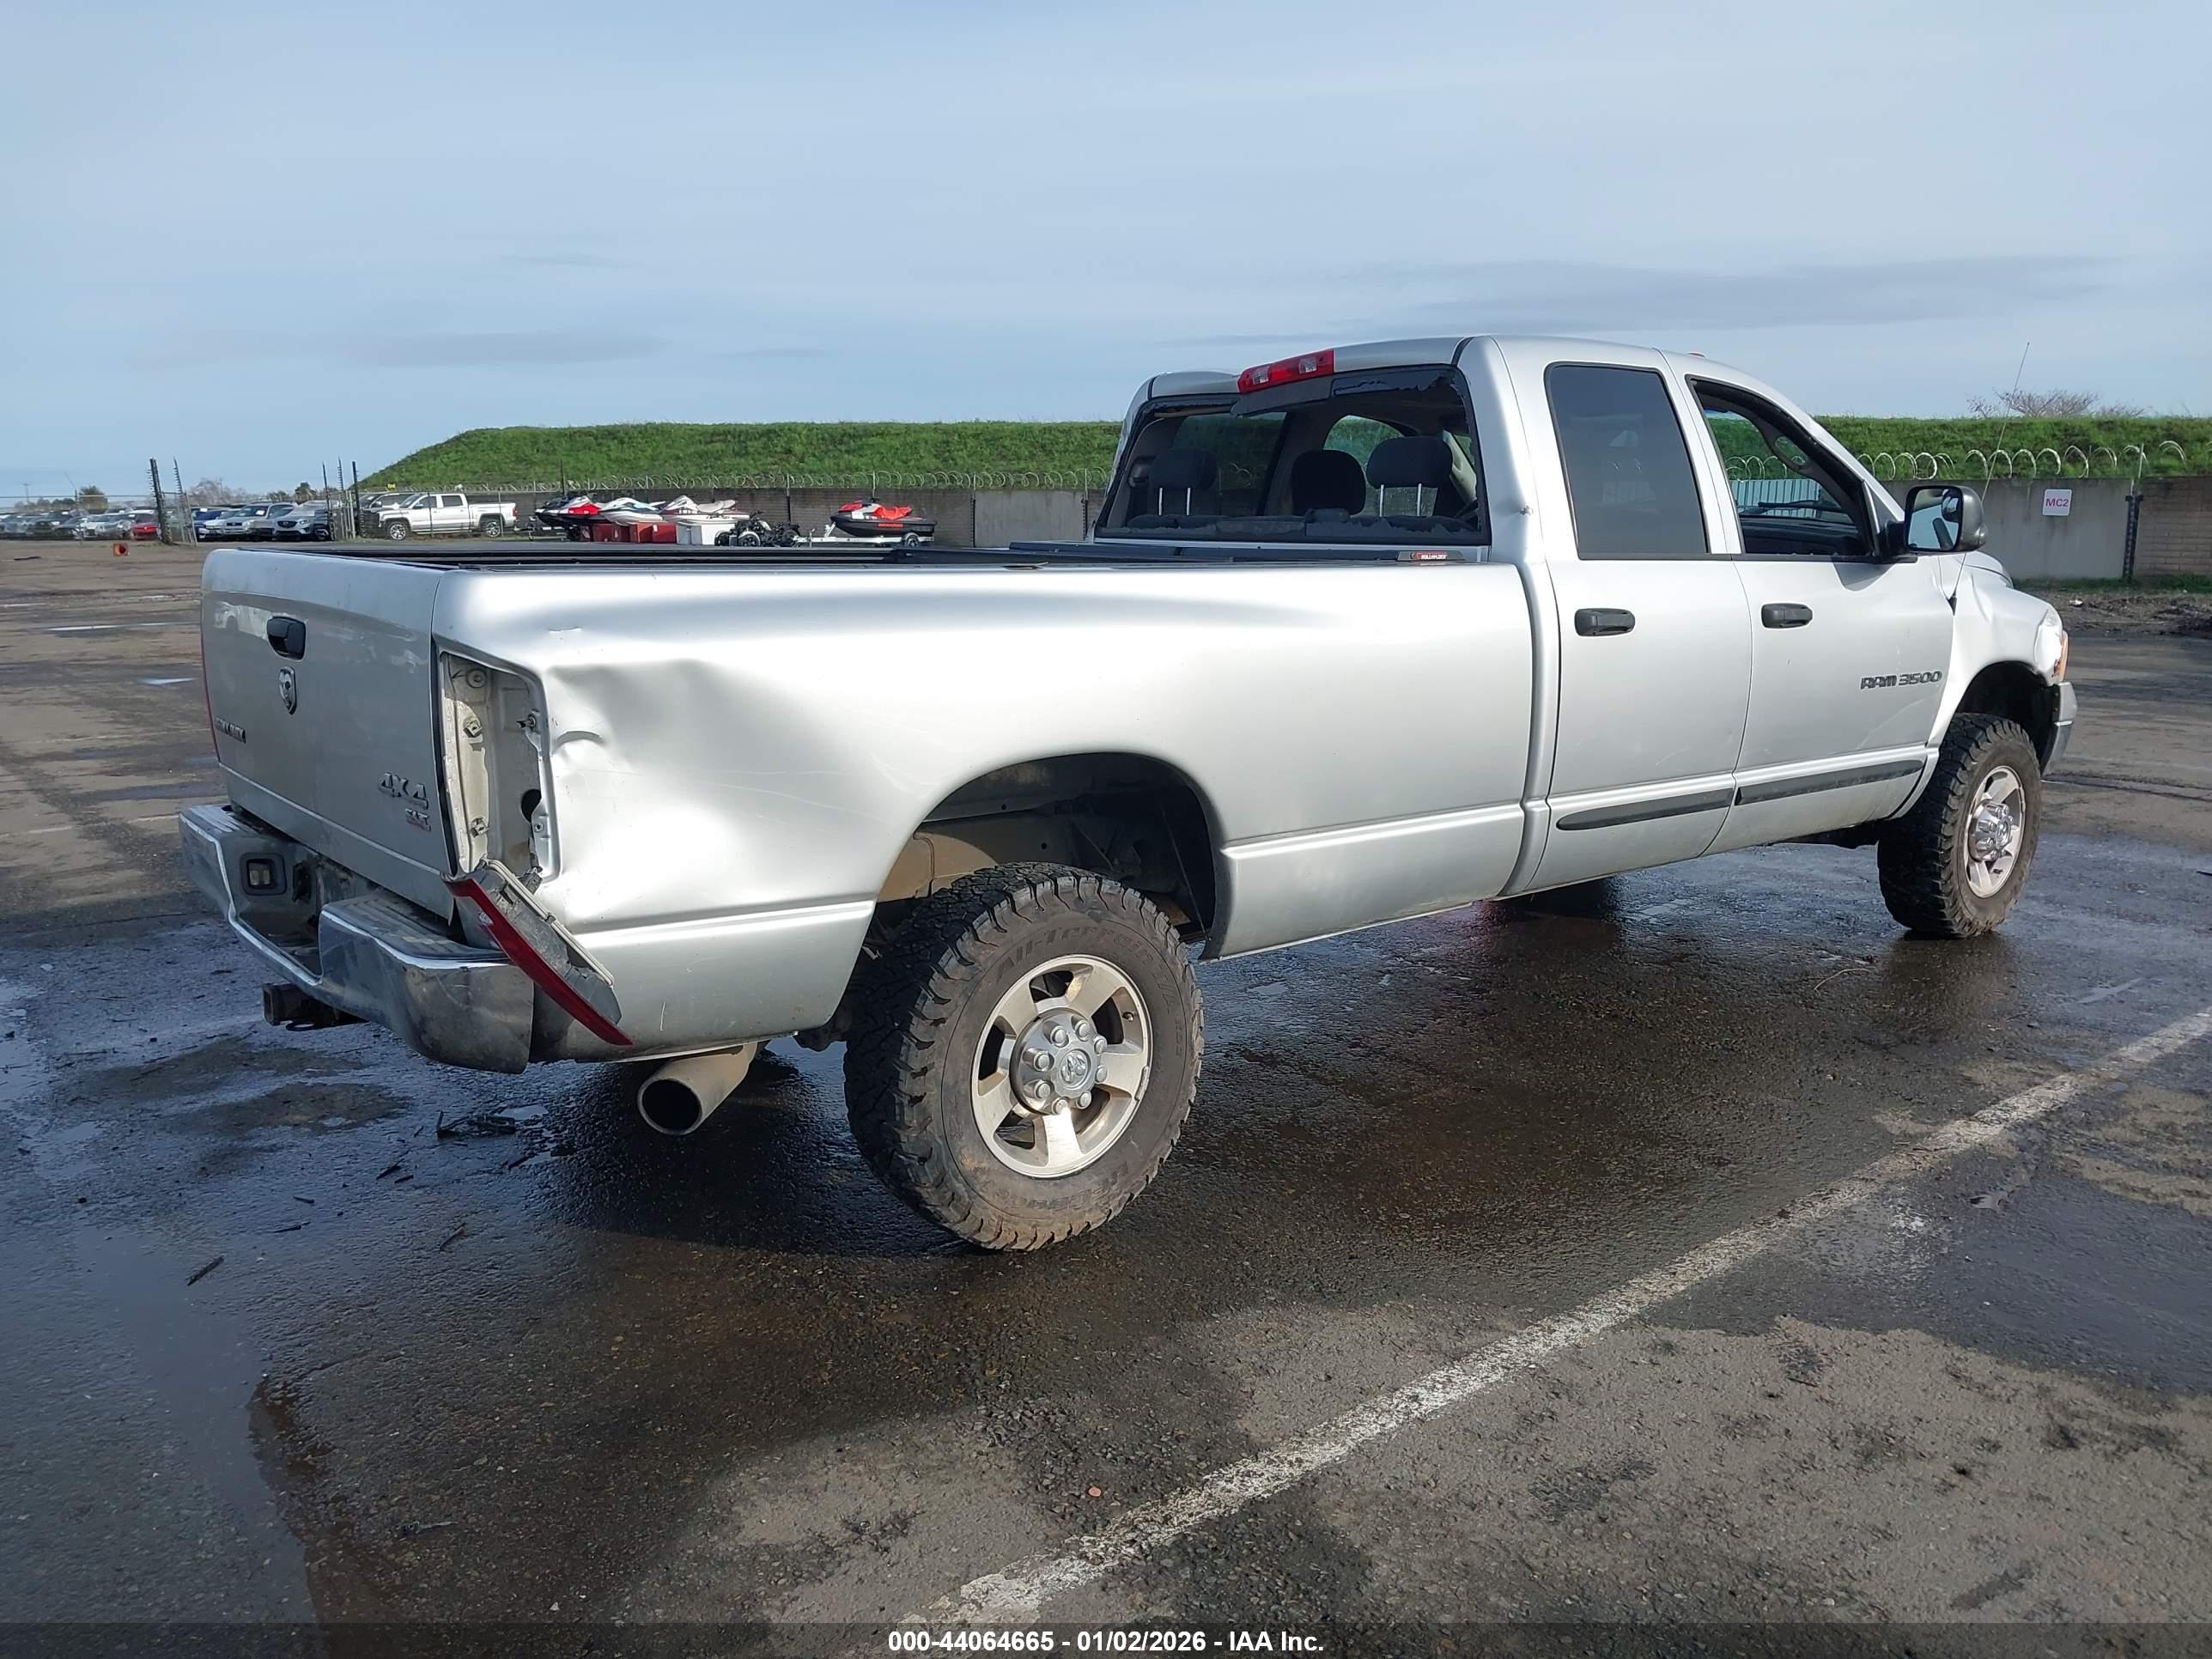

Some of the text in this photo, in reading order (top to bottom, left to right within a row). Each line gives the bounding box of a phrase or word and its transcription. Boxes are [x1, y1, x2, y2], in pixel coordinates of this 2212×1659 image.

[2045, 498, 2069, 507] MC2
[1860, 671, 1942, 690] RAM 3500
